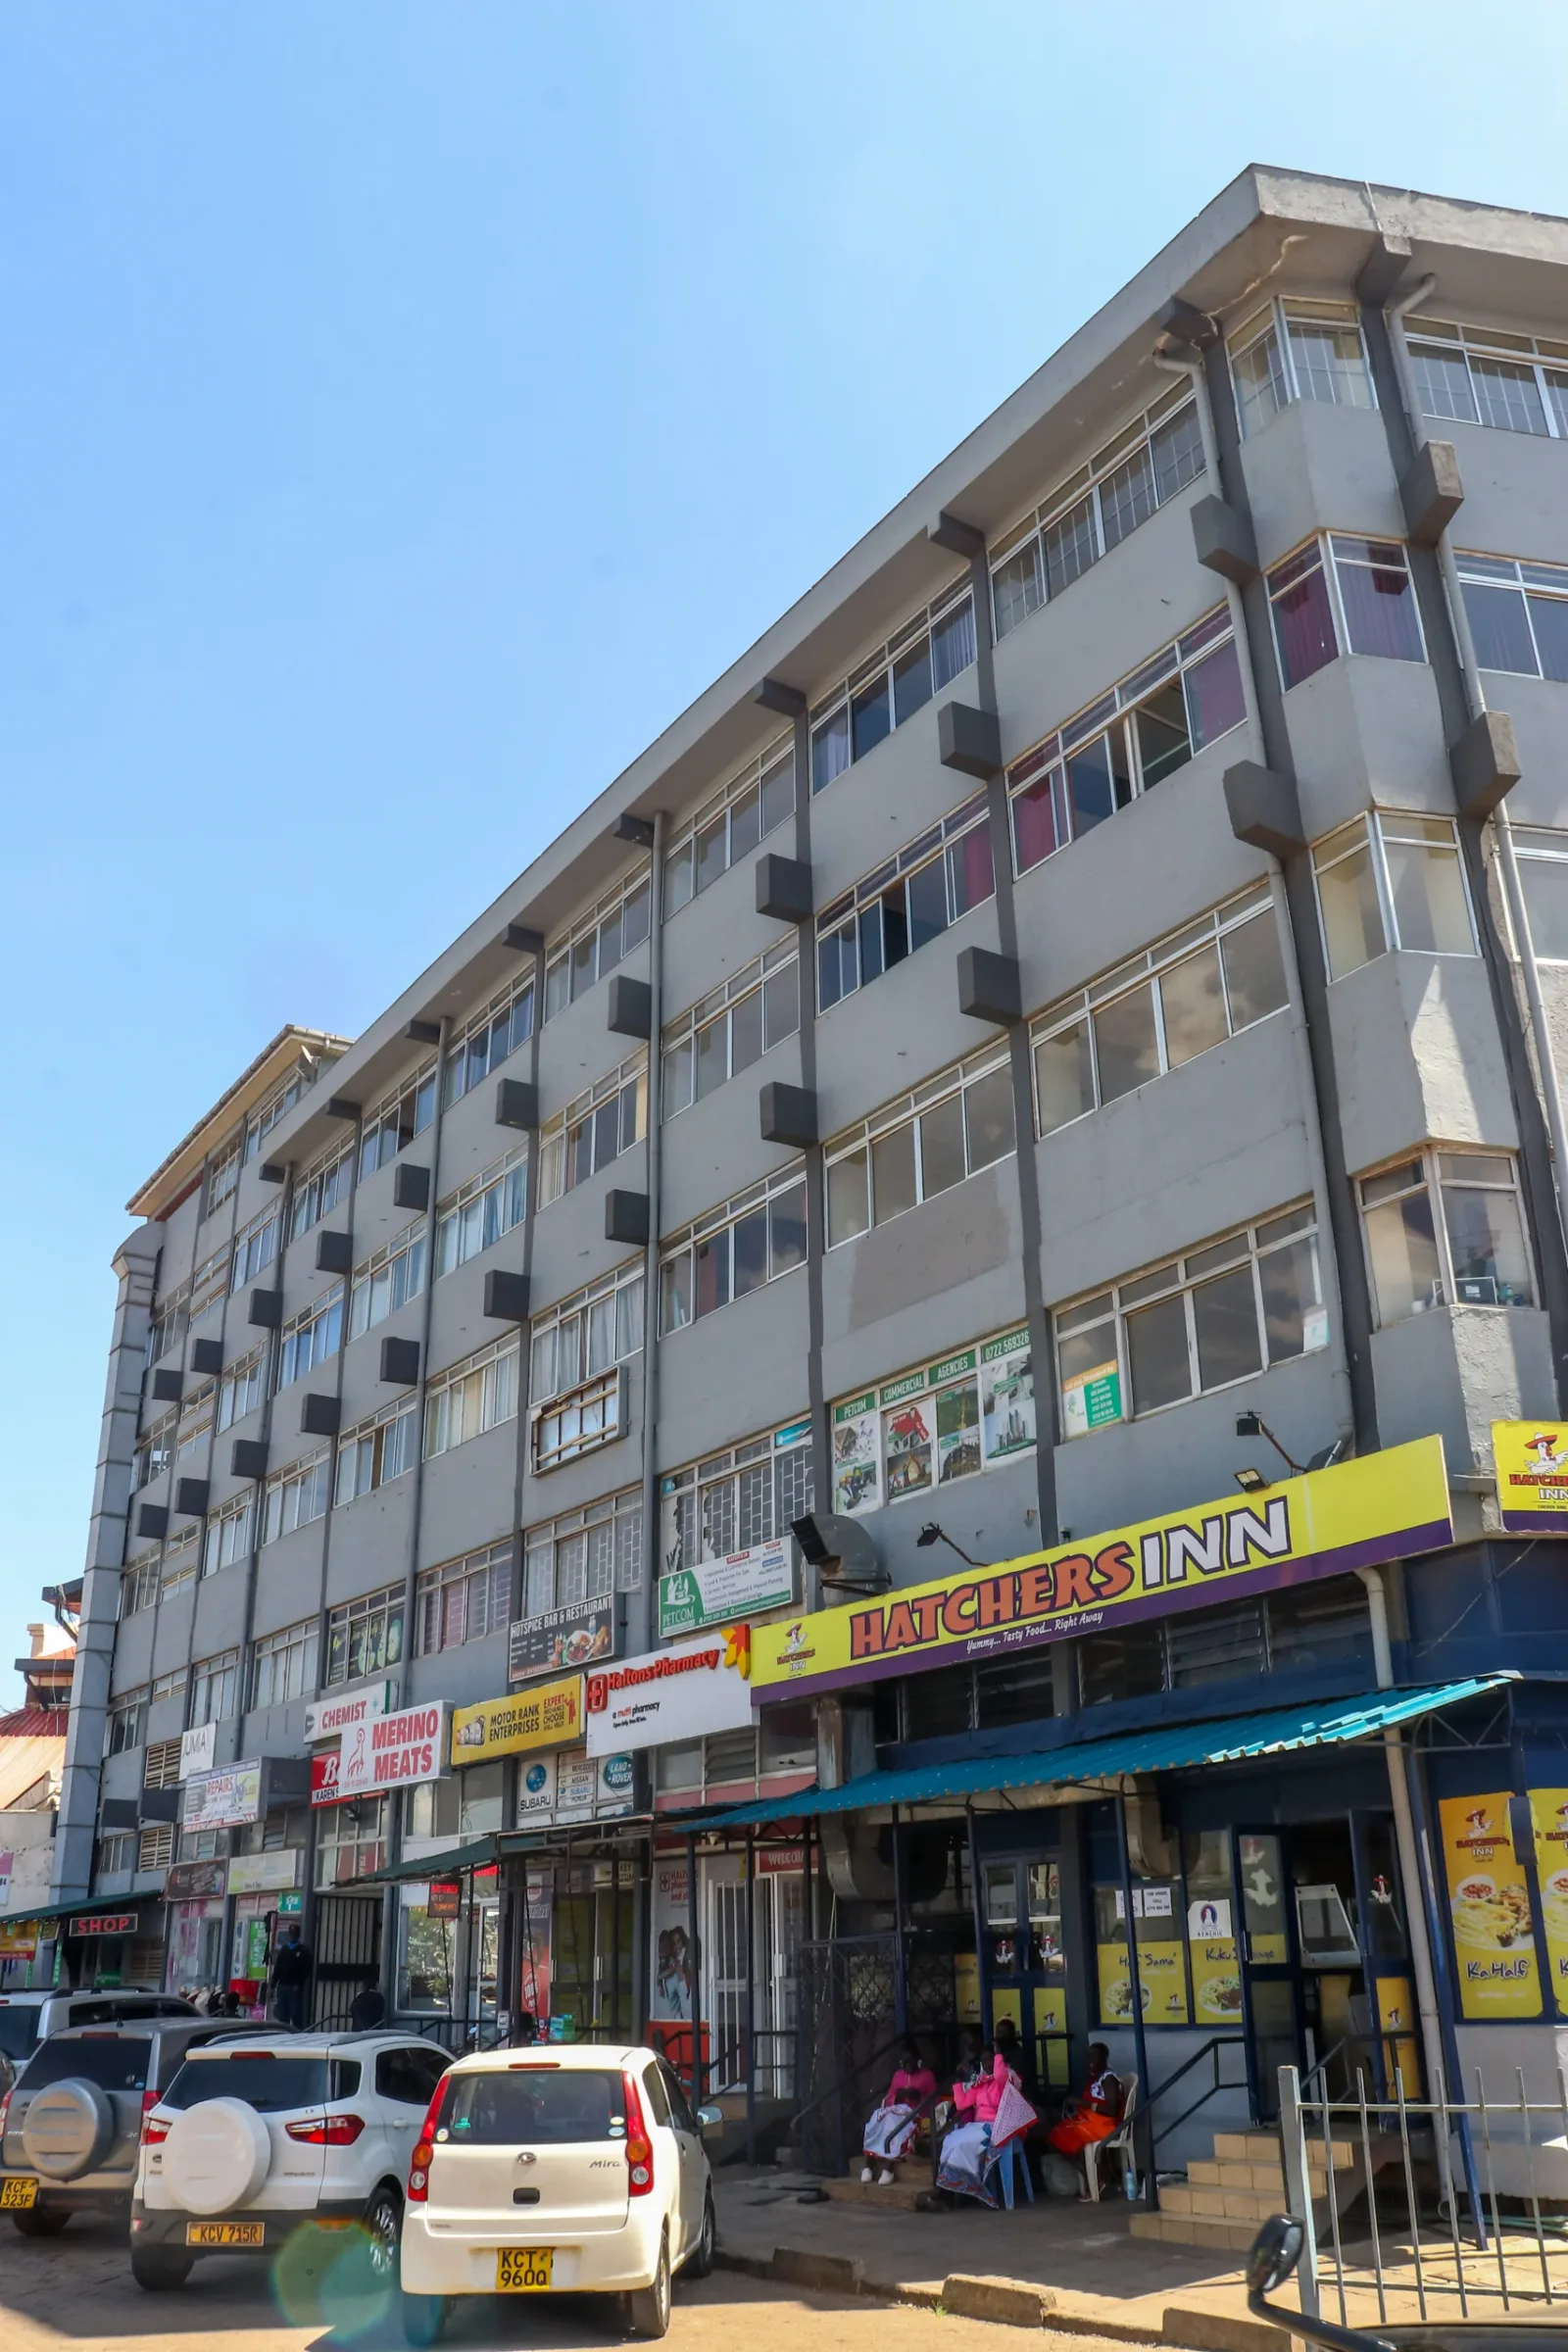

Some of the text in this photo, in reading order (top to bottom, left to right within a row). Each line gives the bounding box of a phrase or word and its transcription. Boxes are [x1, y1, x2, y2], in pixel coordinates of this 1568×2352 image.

[844, 1331, 1029, 1419] PETCOM COMMERCIAL AGENCIES 0722 569326
[1539, 1488, 1568, 1500] INN
[850, 1495, 1292, 1660] HATCHERS INN
[511, 1595, 612, 1639] HOTSPICE BAR & RESTAURANT
[662, 1605, 695, 1627] PETCOM
[1003, 1630, 1023, 1642] Tasty
[1054, 1616, 1077, 1632] Right
[1079, 1611, 1103, 1625] Away
[608, 1648, 720, 1690] Haltons Pharmacy
[790, 1660, 806, 1672] INN
[543, 1693, 565, 1708] EXPERT
[321, 1700, 368, 1730] CHEMIST
[490, 1703, 540, 1726] MOTOR RANK
[543, 1711, 564, 1725] CHOOSE
[632, 1701, 661, 1718] pharmacy
[371, 1708, 439, 1751] MERINO
[489, 1717, 540, 1742] ENTERPRISES
[373, 1742, 432, 1784] MEATS
[609, 1763, 627, 1773] LAND
[207, 1777, 233, 1796] REPAIRS
[571, 1775, 590, 1785] NISSAN
[611, 1771, 633, 1785] ROVER
[316, 1788, 335, 1801] KAREN
[570, 1787, 590, 1795] SUBARU
[519, 1794, 552, 1811] SUBARU
[768, 1851, 805, 1866] WELCOM
[1472, 1847, 1494, 1856] INN
[77, 1917, 129, 1935] SHOP
[1205, 1947, 1231, 1961] Kuku
[1466, 1959, 1530, 1980] Ka Half
[589, 2159, 621, 2169] Mira
[5, 2179, 27, 2192] KCF
[3, 2192, 32, 2207] 323F
[200, 2225, 258, 2242] KCV 715R
[501, 2250, 538, 2269] KCT
[500, 2269, 547, 2287] 960Q
